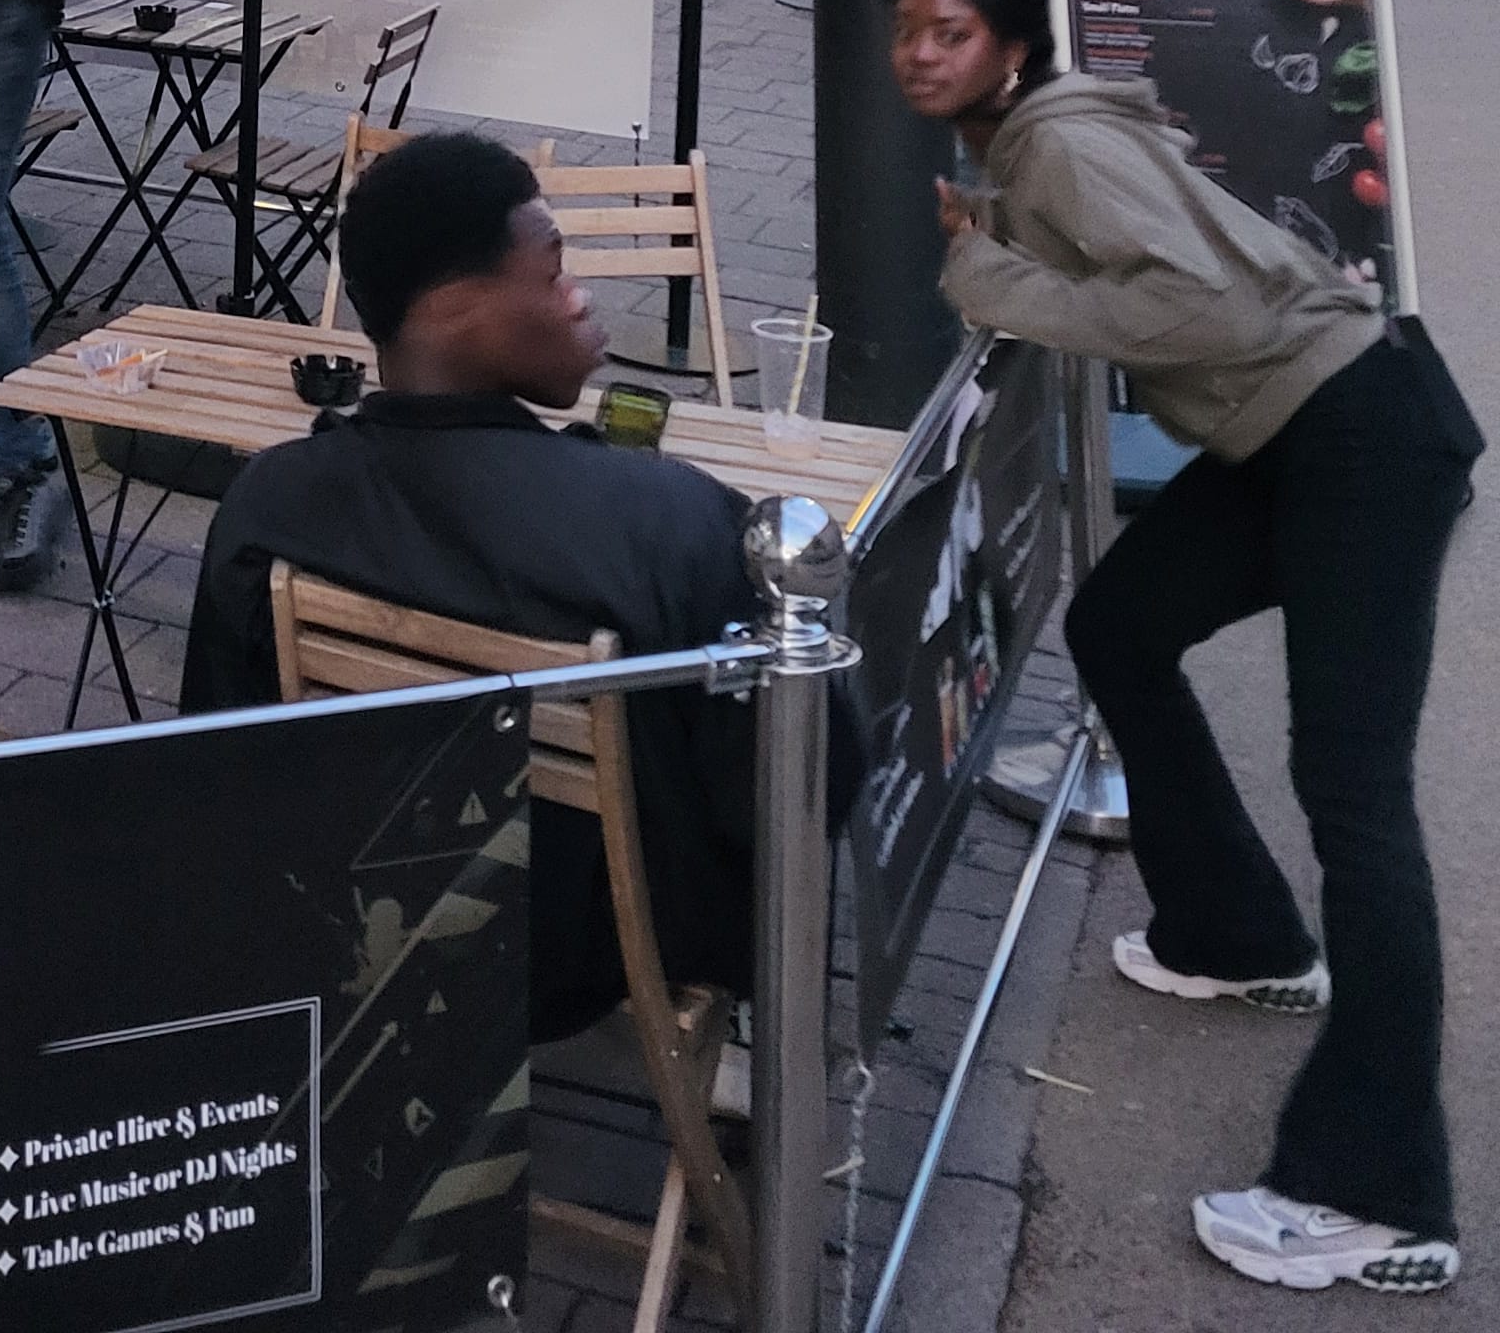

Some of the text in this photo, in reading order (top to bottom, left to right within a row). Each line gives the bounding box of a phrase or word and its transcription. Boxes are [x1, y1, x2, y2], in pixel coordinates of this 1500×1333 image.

[23, 1093, 281, 1168] Private Hire & Events
[23, 1141, 298, 1221] Live Music or DJ Nights
[22, 1205, 256, 1271] Table Games & Fun
